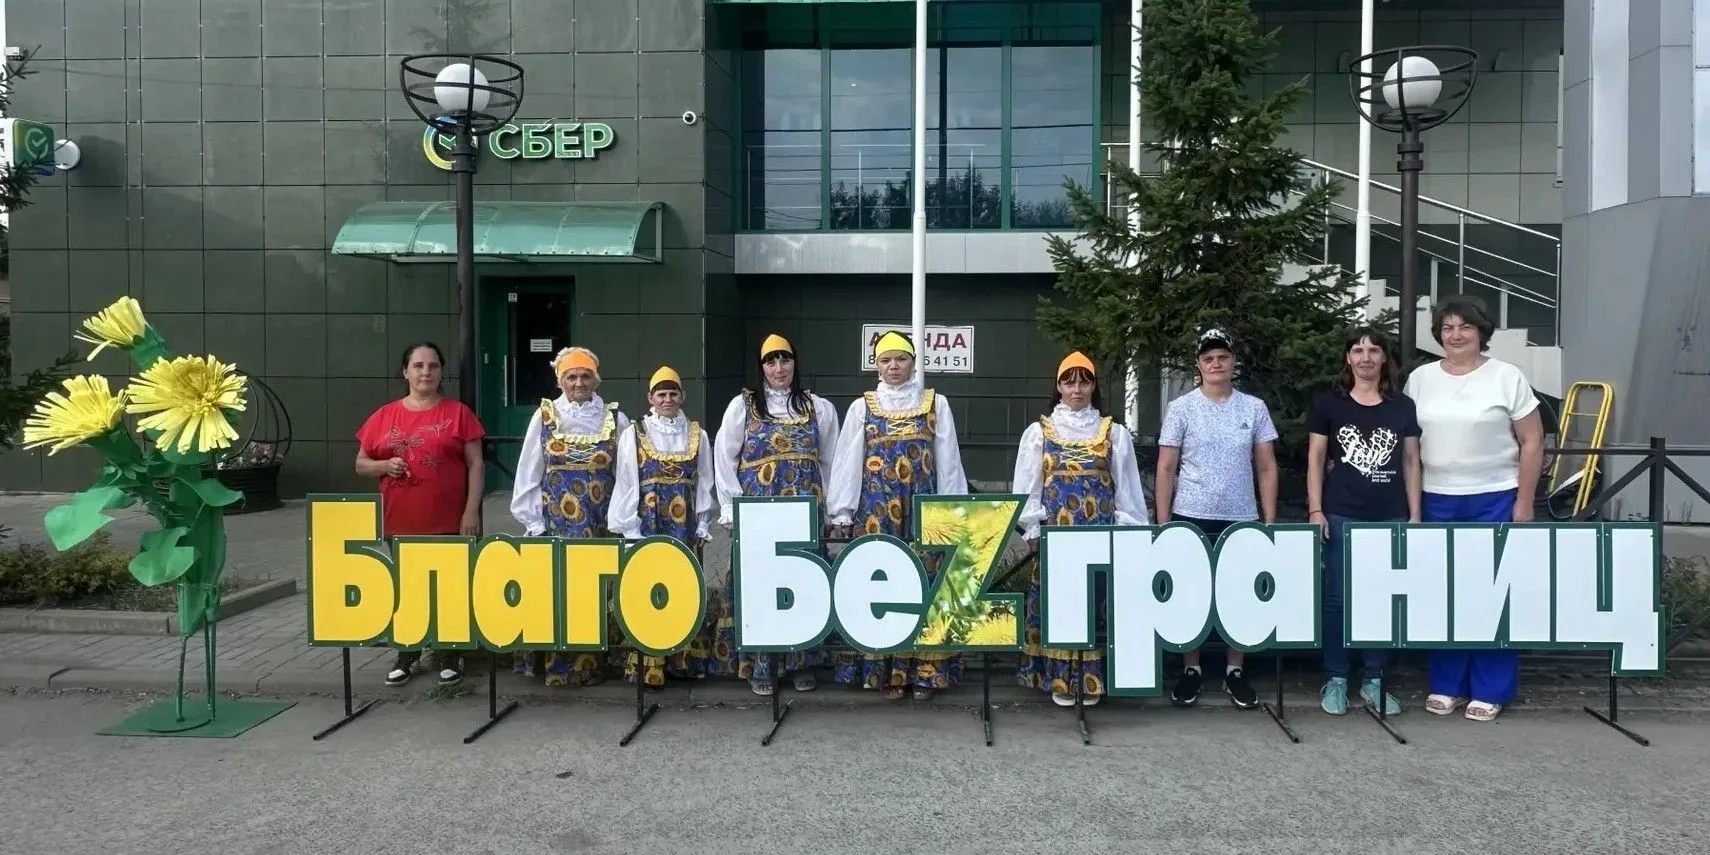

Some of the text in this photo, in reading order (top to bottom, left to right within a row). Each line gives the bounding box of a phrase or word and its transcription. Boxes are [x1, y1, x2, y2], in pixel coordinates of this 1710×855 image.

[489, 122, 614, 159] СБЕР
[869, 331, 967, 351] АНДА
[934, 356, 948, 366] 41
[953, 356, 967, 367] 51
[311, 502, 700, 649] Благо
